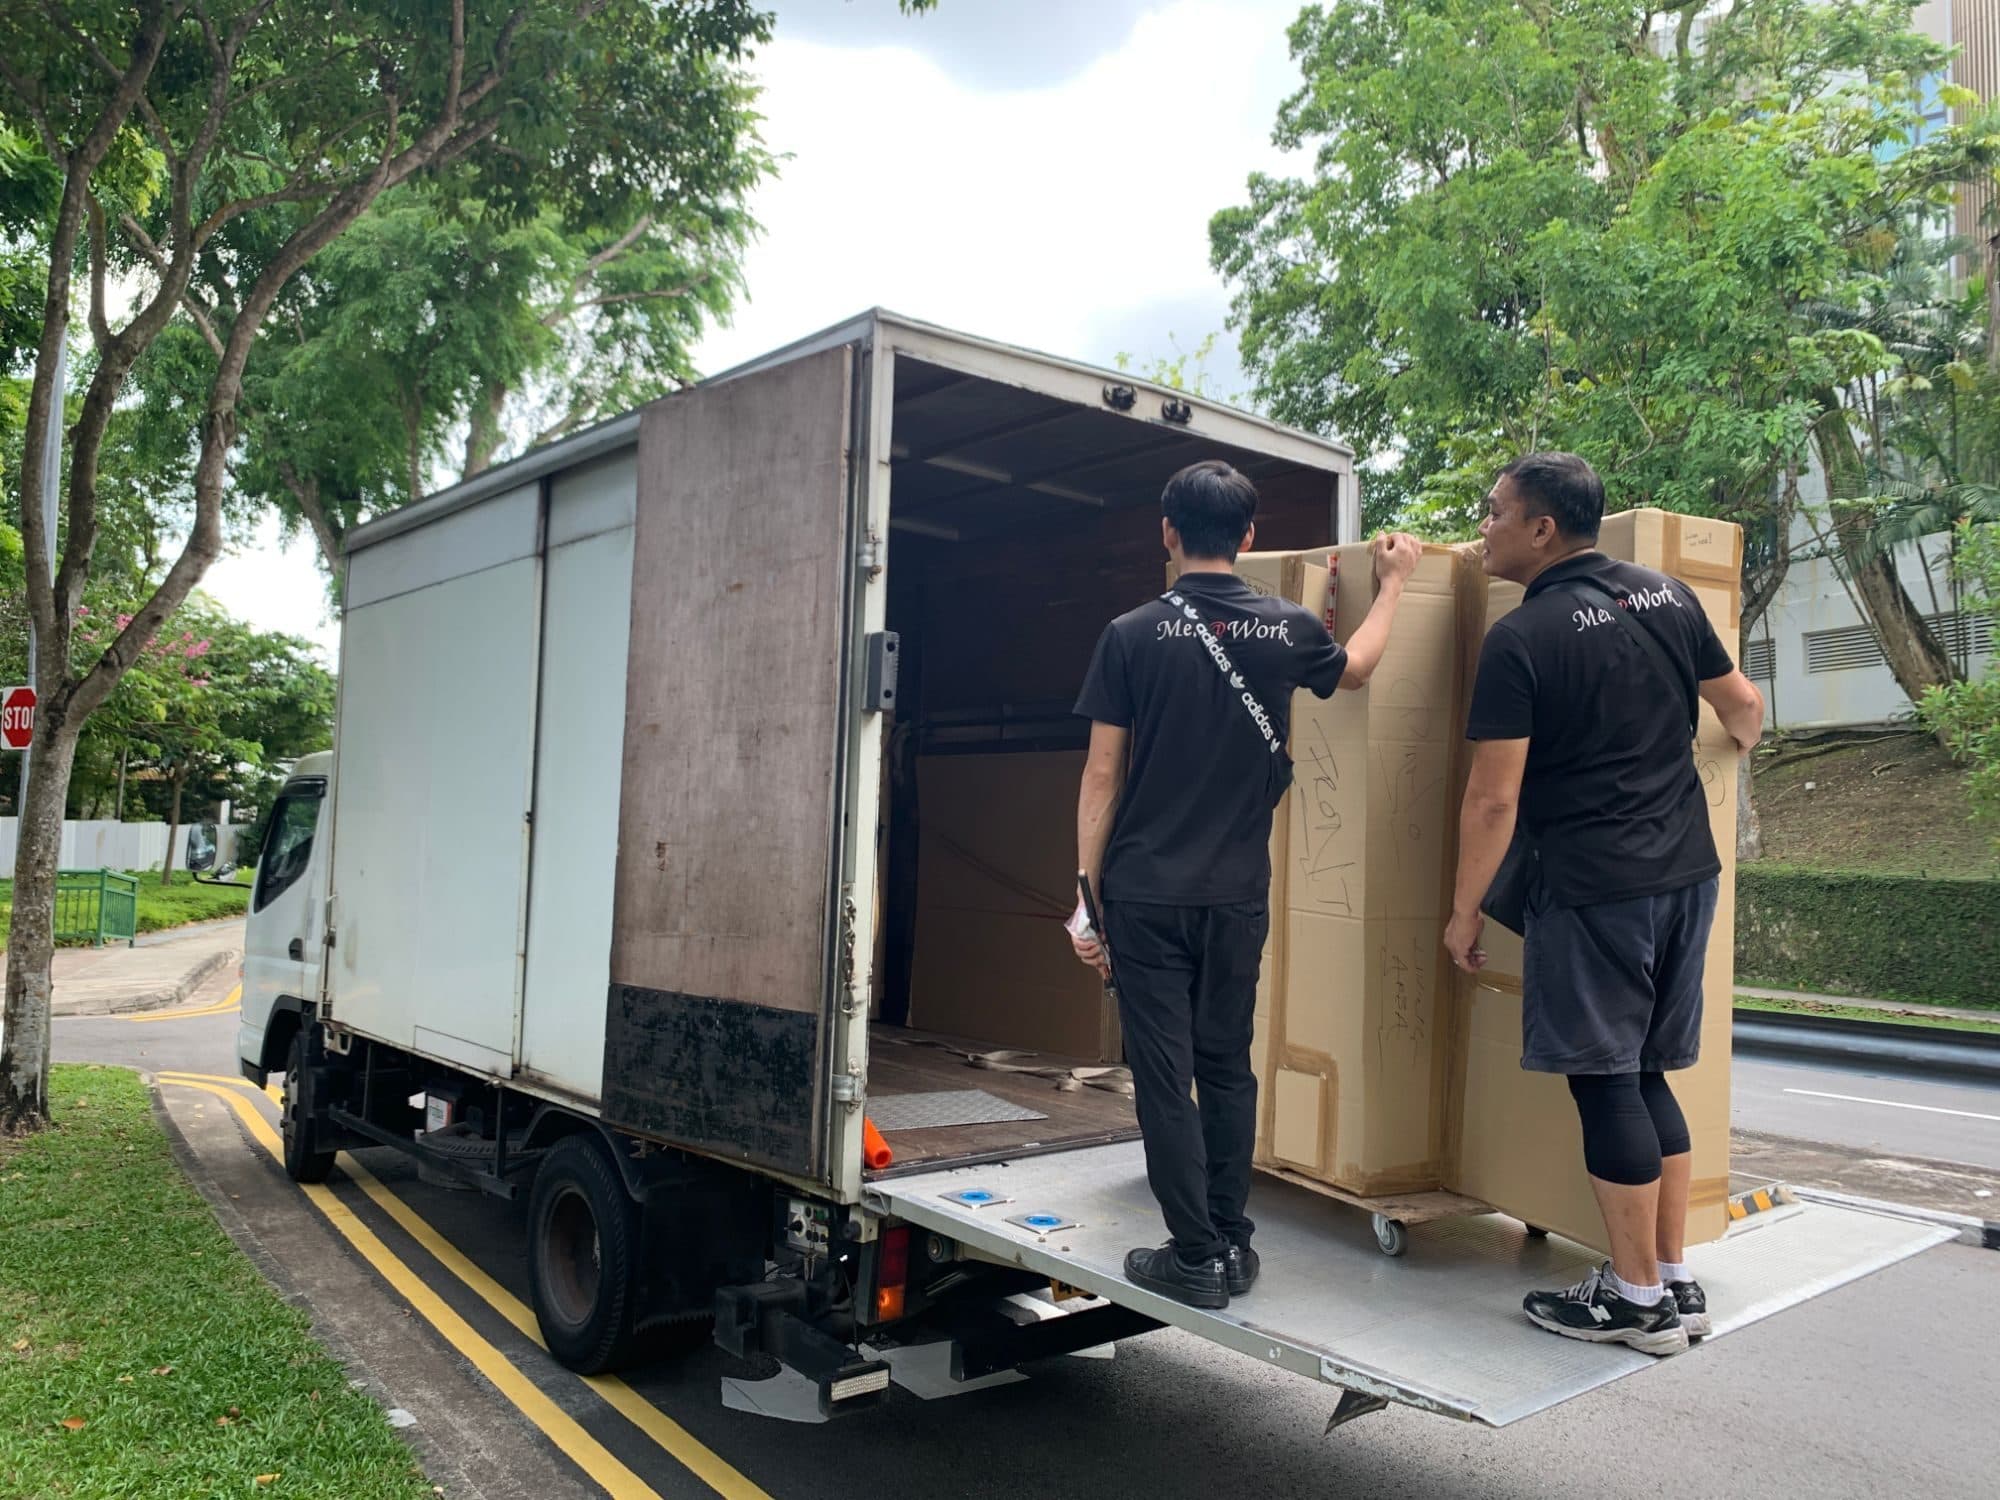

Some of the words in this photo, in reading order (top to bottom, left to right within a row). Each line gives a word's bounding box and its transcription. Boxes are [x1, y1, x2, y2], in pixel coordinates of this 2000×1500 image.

[1157, 617, 1293, 646] Me@Work
[1196, 623, 1231, 672] adidas
[1242, 692, 1274, 741] adidas
